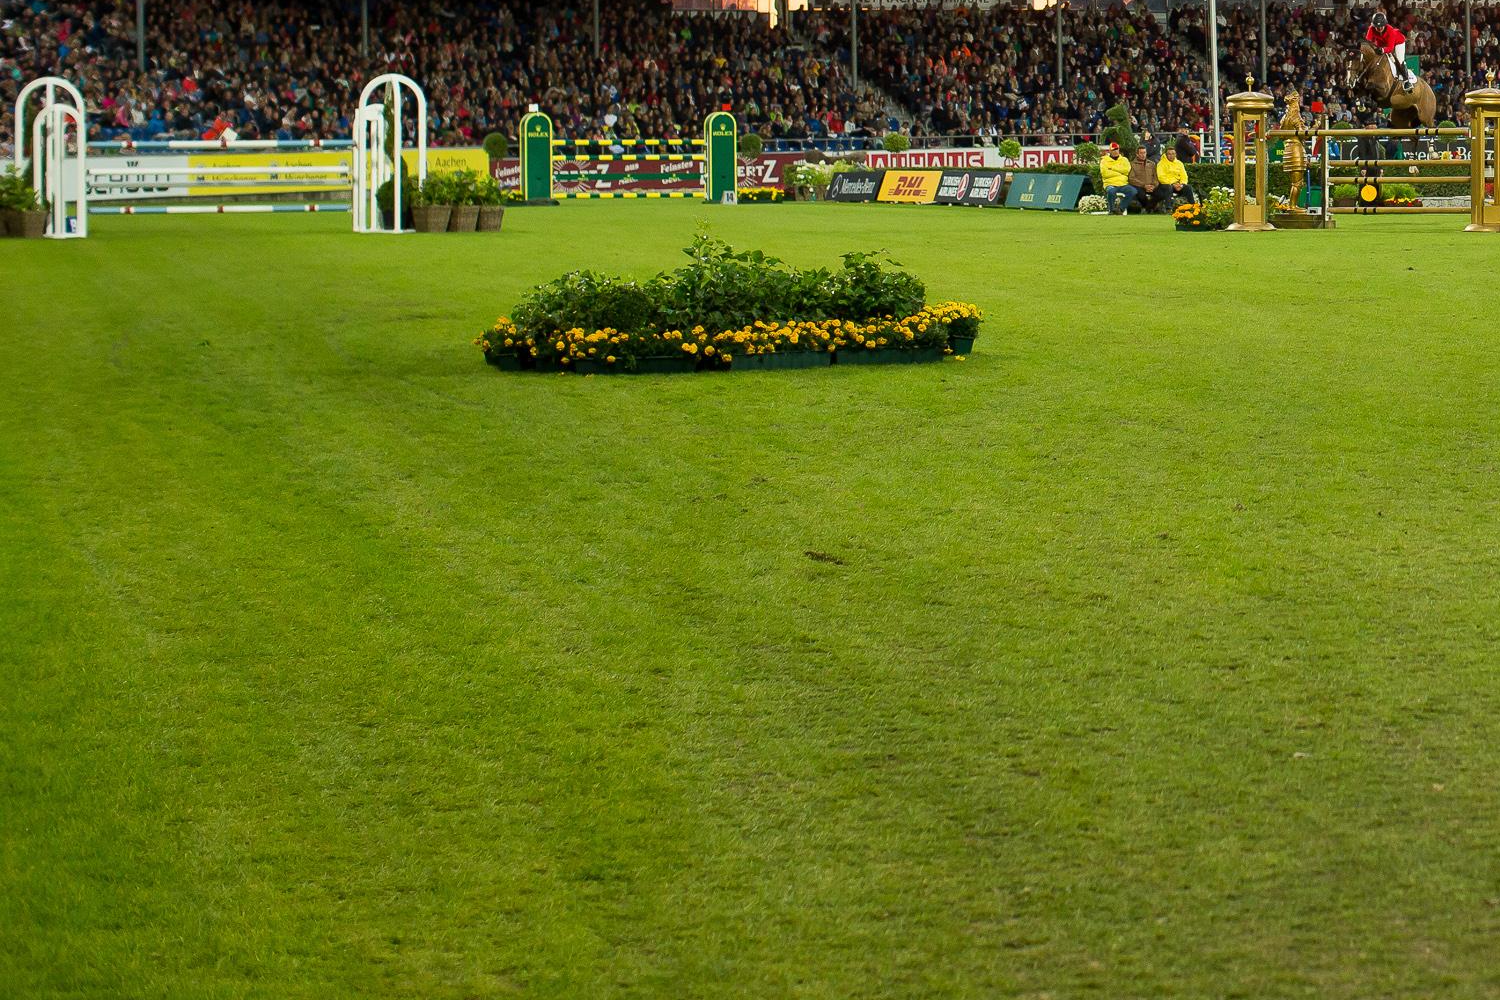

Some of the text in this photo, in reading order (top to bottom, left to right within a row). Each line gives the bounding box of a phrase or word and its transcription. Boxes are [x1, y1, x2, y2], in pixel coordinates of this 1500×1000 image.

[435, 156, 467, 167] Aachen
[866, 151, 985, 168] AUHAUS
[842, 178, 876, 194] Mercedes-Benz
[973, 177, 994, 187] TURKISH
